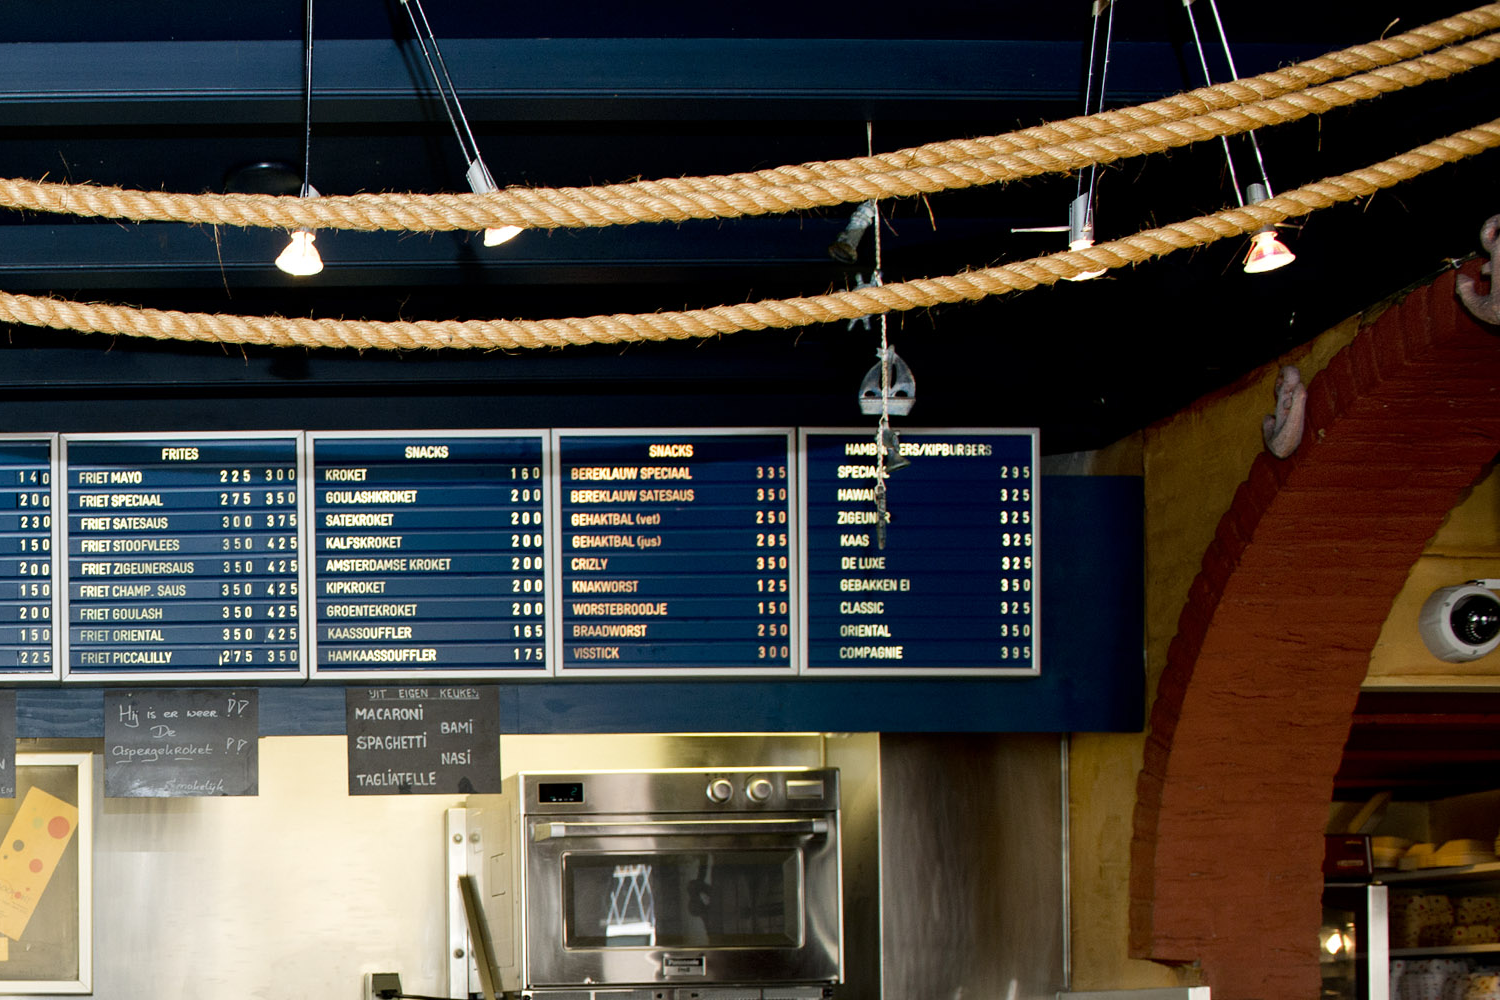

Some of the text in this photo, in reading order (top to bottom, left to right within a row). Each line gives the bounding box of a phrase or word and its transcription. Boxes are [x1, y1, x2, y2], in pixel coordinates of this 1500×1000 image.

[162, 448, 199, 460] FRITES
[405, 446, 448, 458] SNACKS
[649, 445, 693, 457] SNACKS
[80, 471, 142, 484] FRIET MAYO
[326, 469, 367, 481] KROKET
[571, 467, 692, 480] BEREKLAUW SPECIAAL
[80, 495, 163, 507] FRIET SPECIAAL
[326, 490, 417, 503] GOULASHKROKET
[81, 517, 168, 530] FRIET SATESAUS
[326, 514, 394, 526] SATEKROKET
[571, 513, 660, 526] GEHAKTBAL (vet)
[838, 512, 891, 524] ZIGEUNR
[326, 537, 402, 549] KALFSKROKET
[572, 535, 661, 549] GEHAKTBAL (jus)
[841, 534, 869, 546] KAAS
[326, 559, 451, 572] AMSTERDAMSE KROKET
[571, 558, 607, 570] CRIZLY
[842, 557, 885, 569] DE LUXE
[326, 582, 385, 593] KIPKROKET
[572, 581, 638, 593] KNAKWORST
[840, 579, 910, 591] GEBAKKEN EI
[327, 604, 417, 617] GROENTEKROKET
[573, 603, 667, 615] WORSTEBROODJE
[840, 602, 884, 614] CLASSIC
[328, 627, 412, 639] KAASSOUFFLER
[573, 625, 647, 637] BRAADWORST
[841, 625, 891, 637] ORIENTAL
[329, 649, 436, 661] HAMKAASSOUFFLER
[574, 647, 619, 659] VISSTICK
[840, 646, 903, 659] COMPAGNIE
[368, 690, 387, 699] UIT
[399, 689, 428, 698] EIGEN
[355, 704, 424, 720] MACARONI
[150, 725, 176, 738] De
[441, 719, 473, 734] BAMI
[356, 732, 427, 750] SPAGHETTI
[441, 750, 471, 765] NASI
[357, 769, 436, 786] TAGLIATELLE
